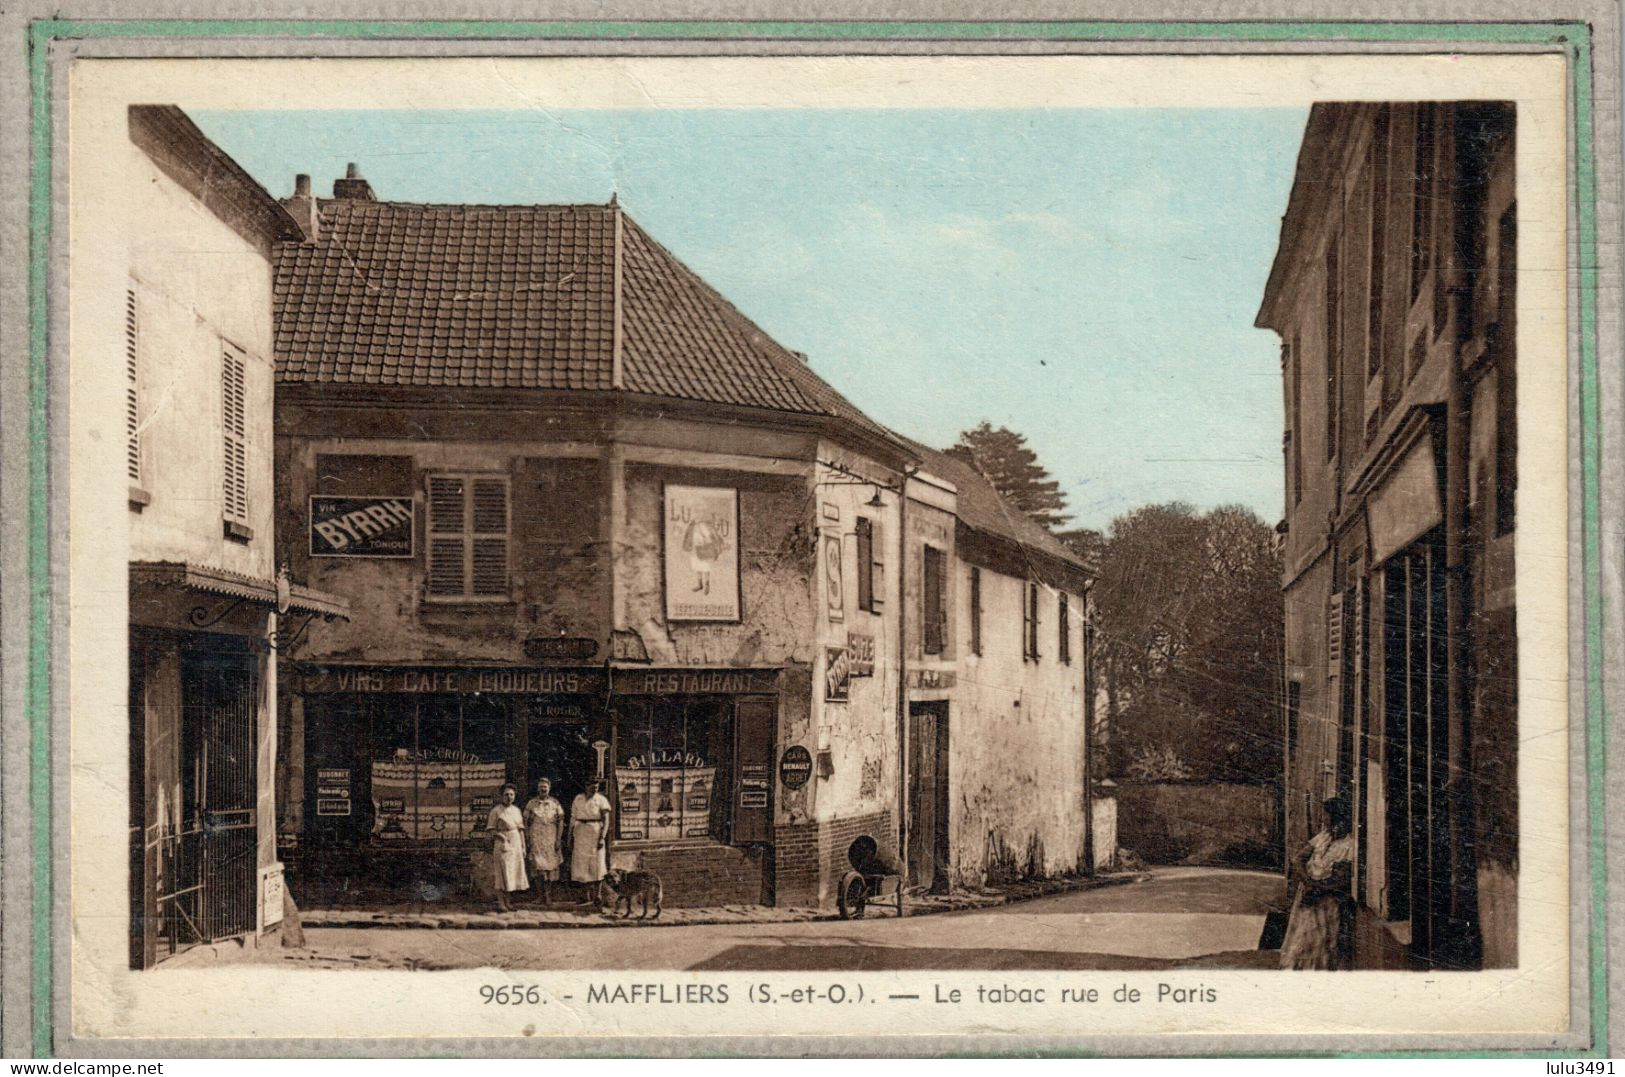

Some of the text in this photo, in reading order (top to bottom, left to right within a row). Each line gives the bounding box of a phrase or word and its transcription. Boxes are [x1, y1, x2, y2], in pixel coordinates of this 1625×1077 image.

[319, 503, 337, 513] VIN
[669, 499, 692, 524] LU
[313, 499, 412, 550] BYRRH
[369, 540, 409, 549] TONIQUE
[849, 639, 875, 665] SUZE
[337, 671, 384, 691] VINS
[478, 671, 579, 692] LIQUEURS
[644, 673, 754, 693] RESTAURANT
[628, 750, 704, 769] BILLARD
